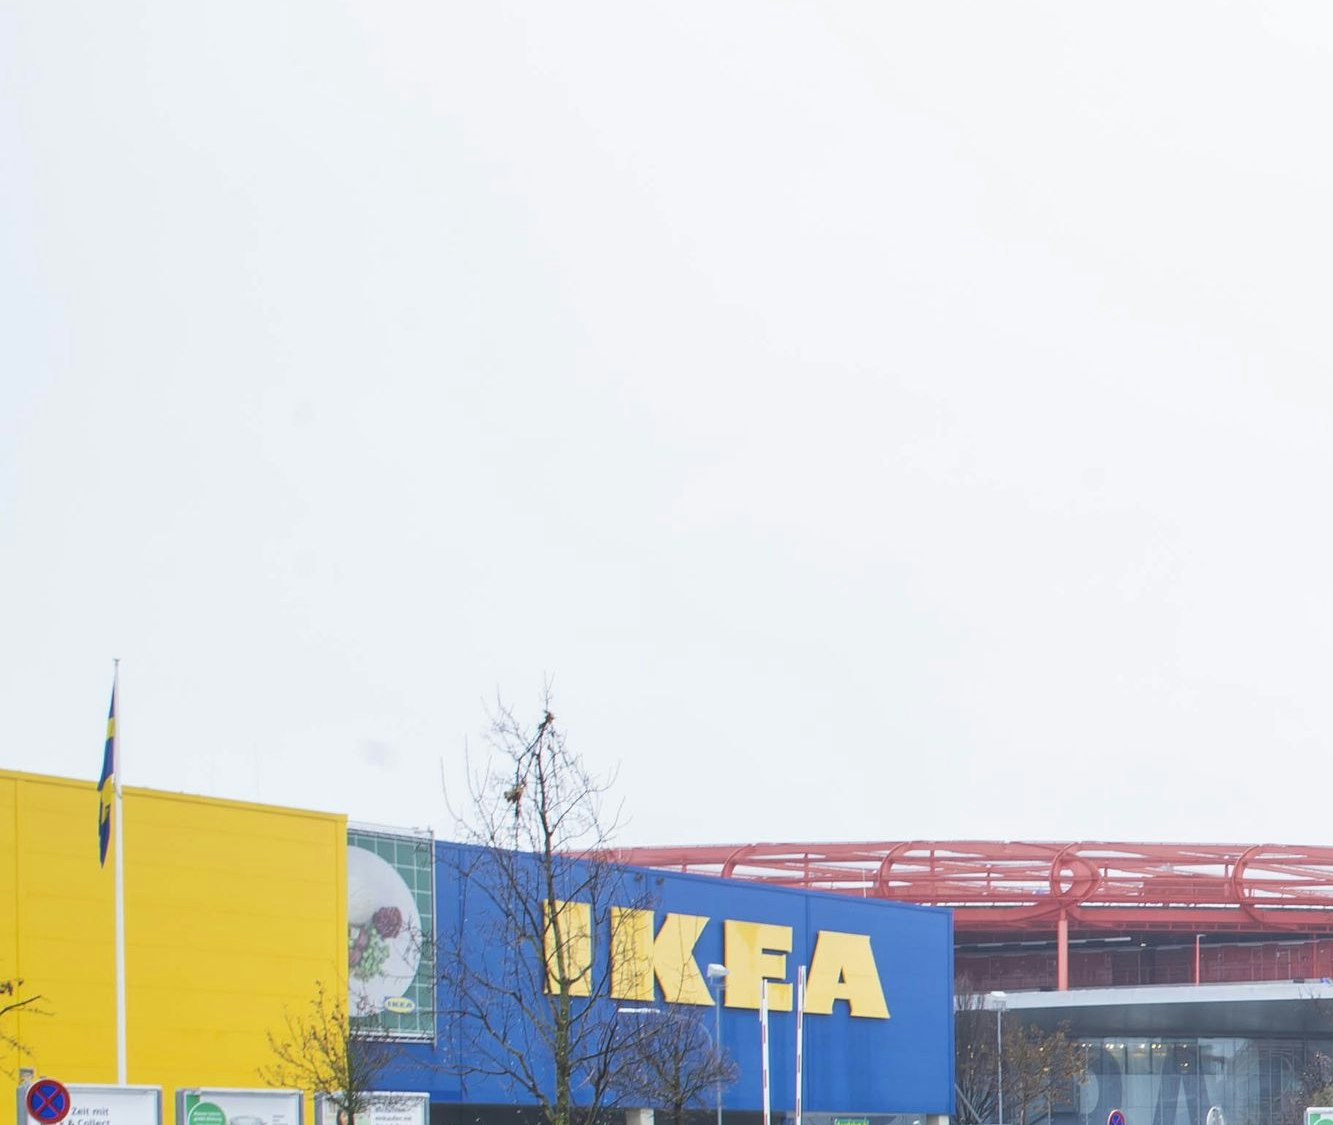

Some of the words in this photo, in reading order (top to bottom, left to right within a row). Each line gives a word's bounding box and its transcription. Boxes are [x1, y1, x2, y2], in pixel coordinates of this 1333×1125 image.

[543, 900, 891, 1019] IKEA
[387, 1000, 413, 1008] IKEA
[71, 1107, 90, 1115] Zeit
[92, 1107, 109, 1115] mit
